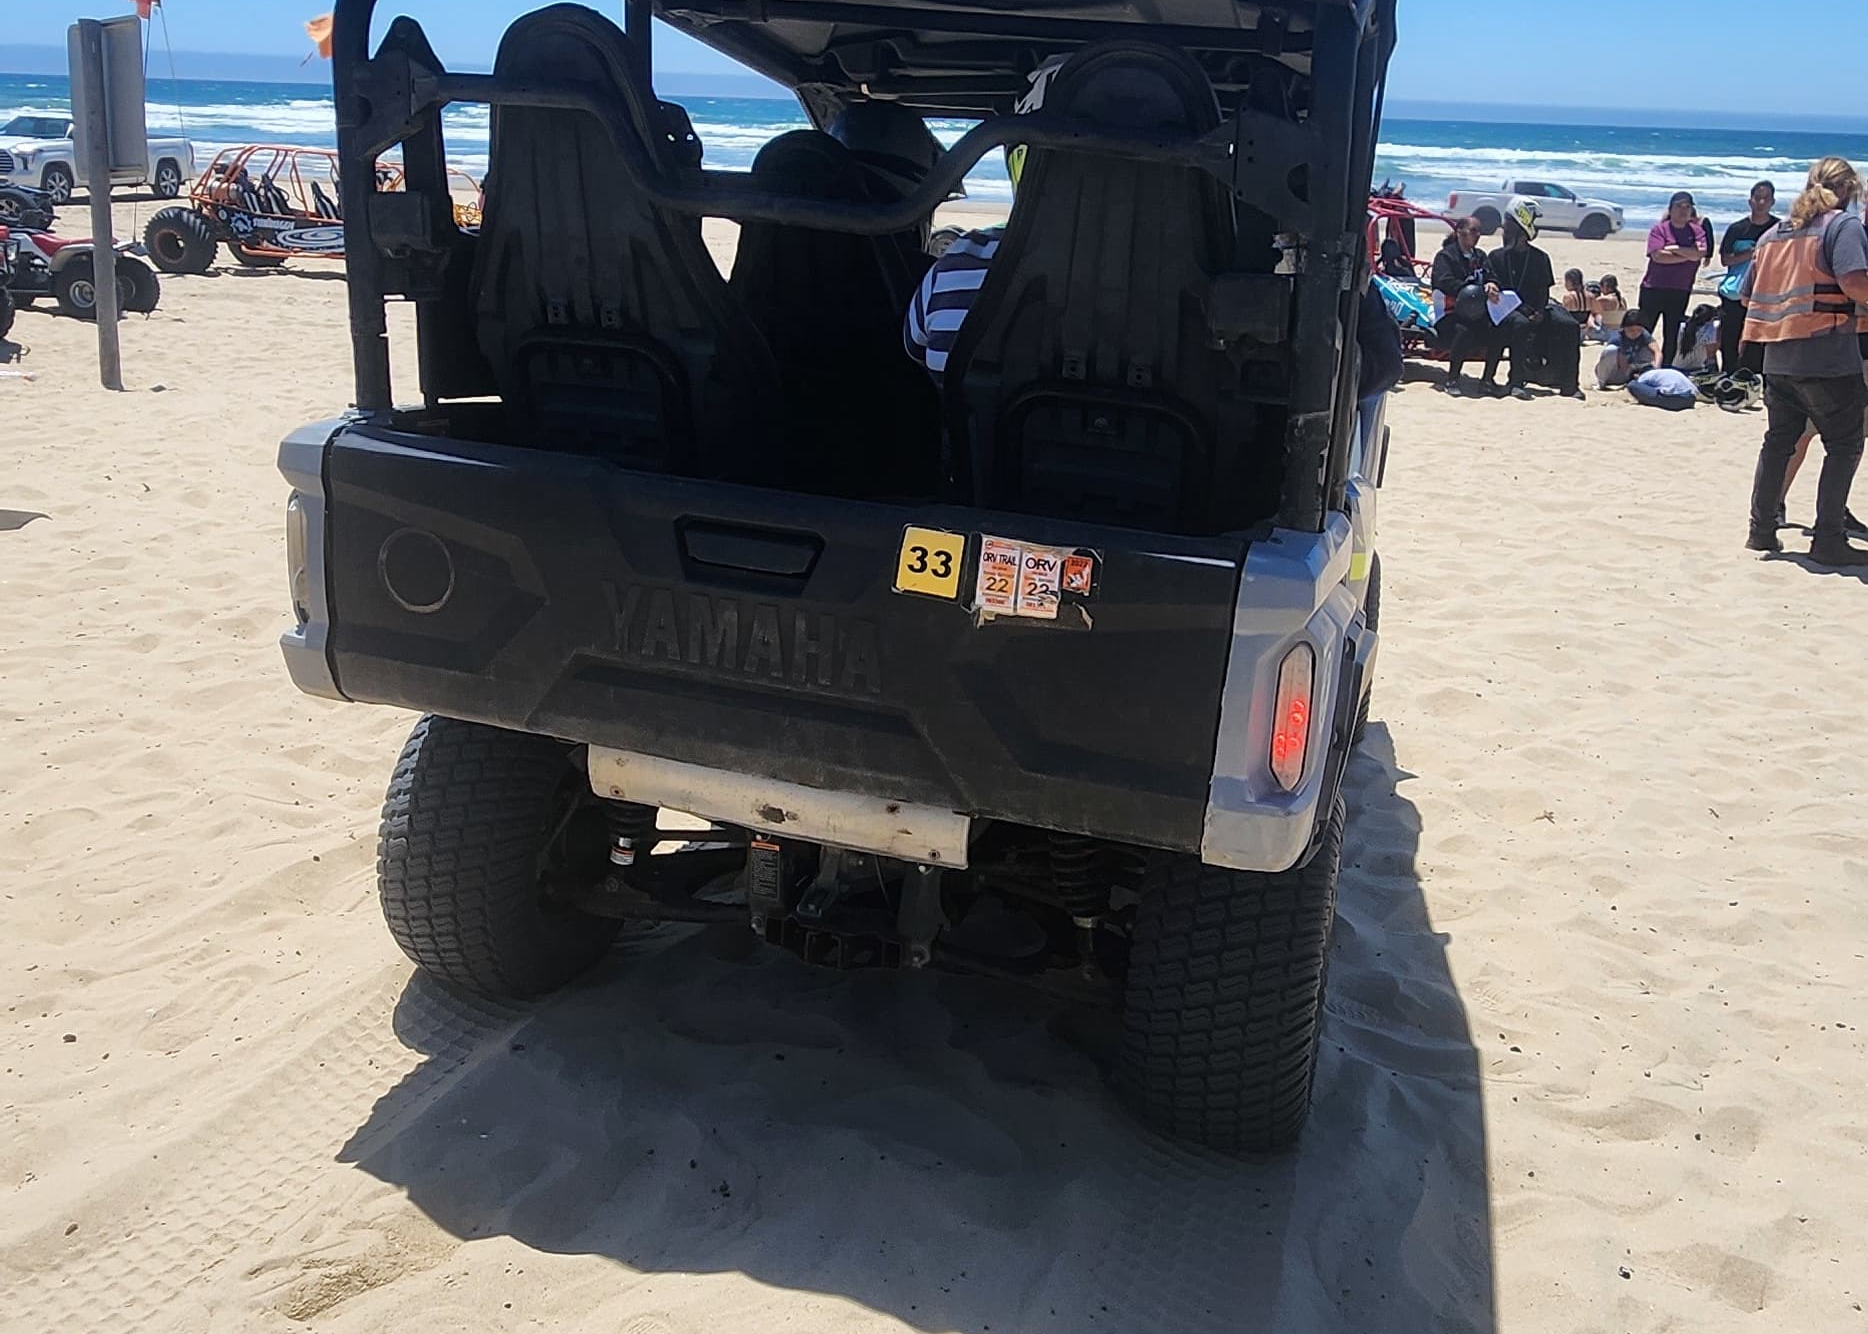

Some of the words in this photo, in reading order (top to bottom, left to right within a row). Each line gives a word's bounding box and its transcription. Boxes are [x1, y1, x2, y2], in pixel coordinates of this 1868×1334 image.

[907, 545, 953, 579] 33
[982, 551, 998, 563] ORV
[1025, 557, 1058, 572] ORV
[985, 576, 1009, 594] 22
[1026, 581, 1050, 596] 22
[601, 578, 881, 693] YAMAHA
